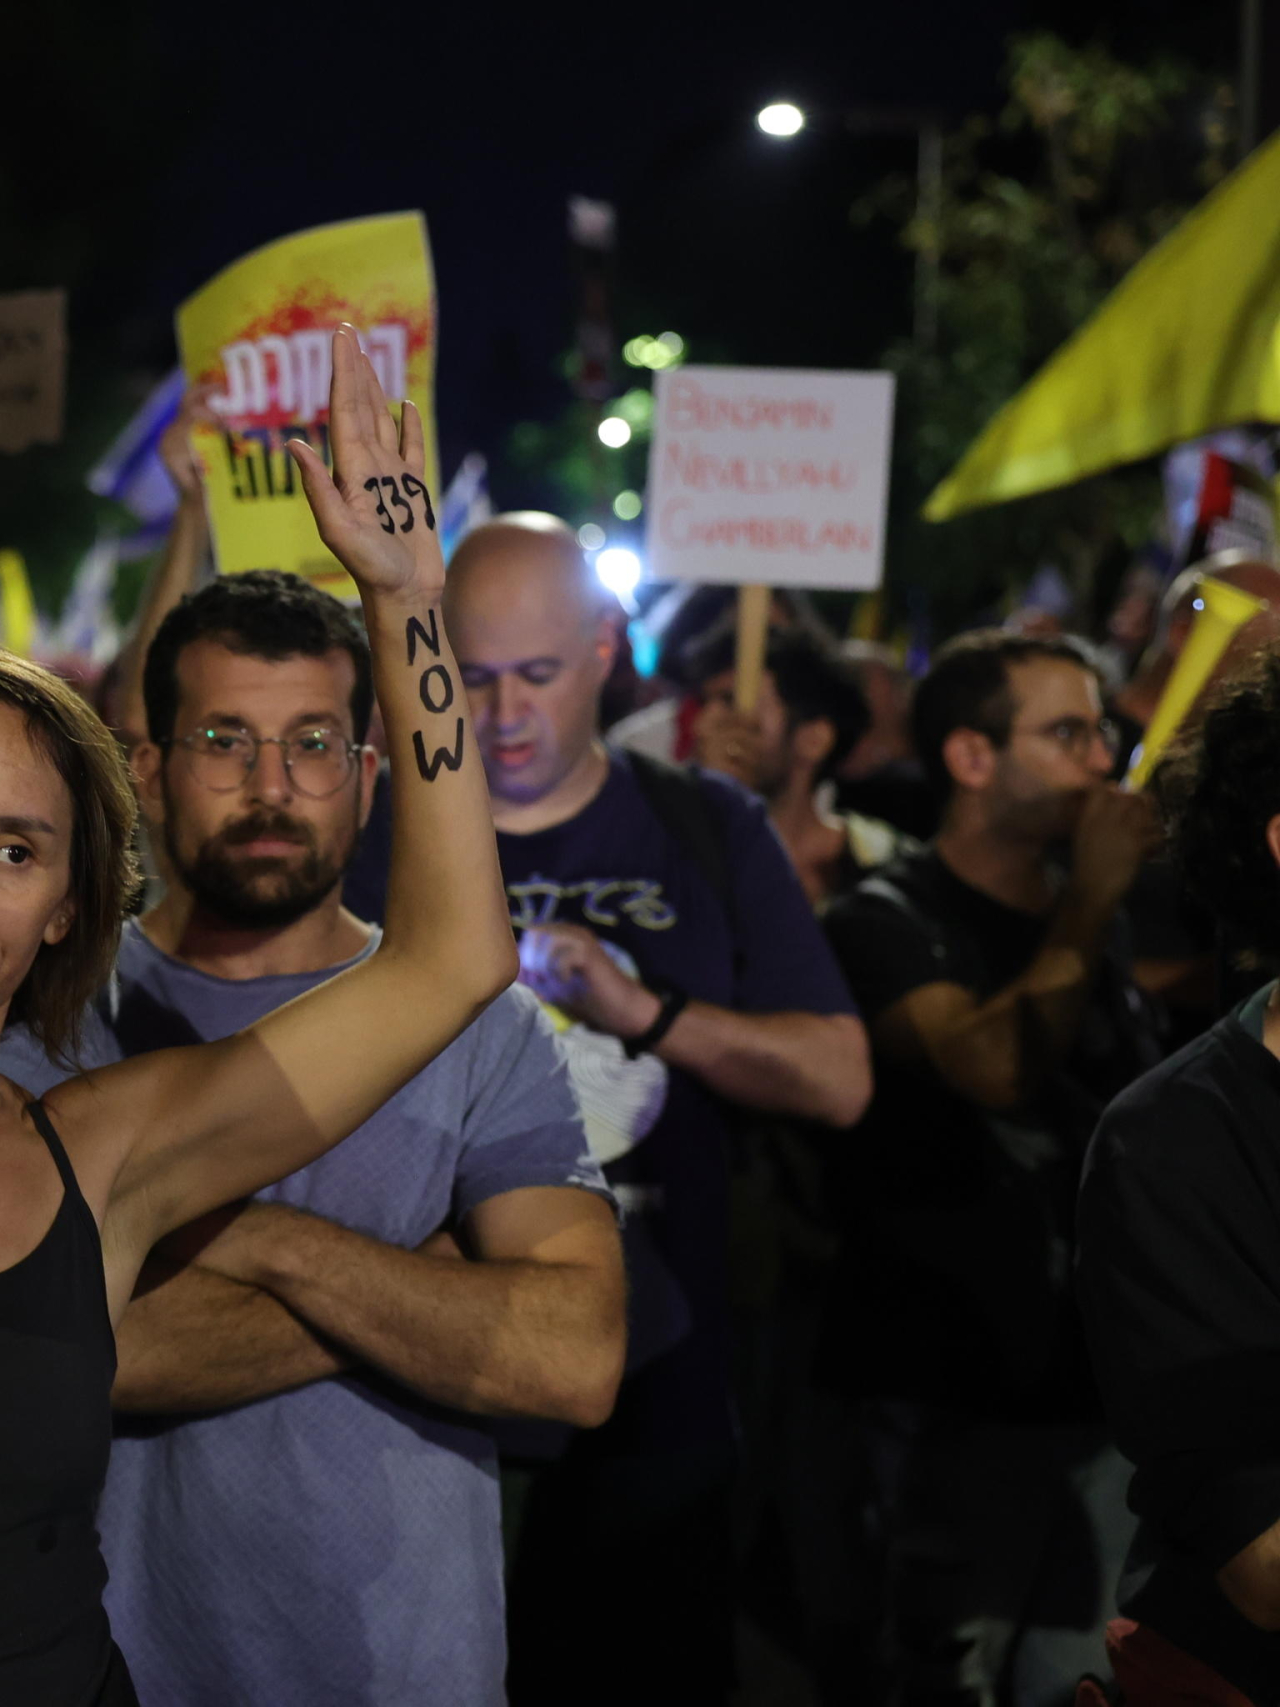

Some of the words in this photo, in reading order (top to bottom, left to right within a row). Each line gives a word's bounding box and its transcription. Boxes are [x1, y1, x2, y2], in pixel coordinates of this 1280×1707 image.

[206, 323, 407, 422] הקרת
[363, 472, 436, 535] 339
[405, 608, 464, 783] NOW
